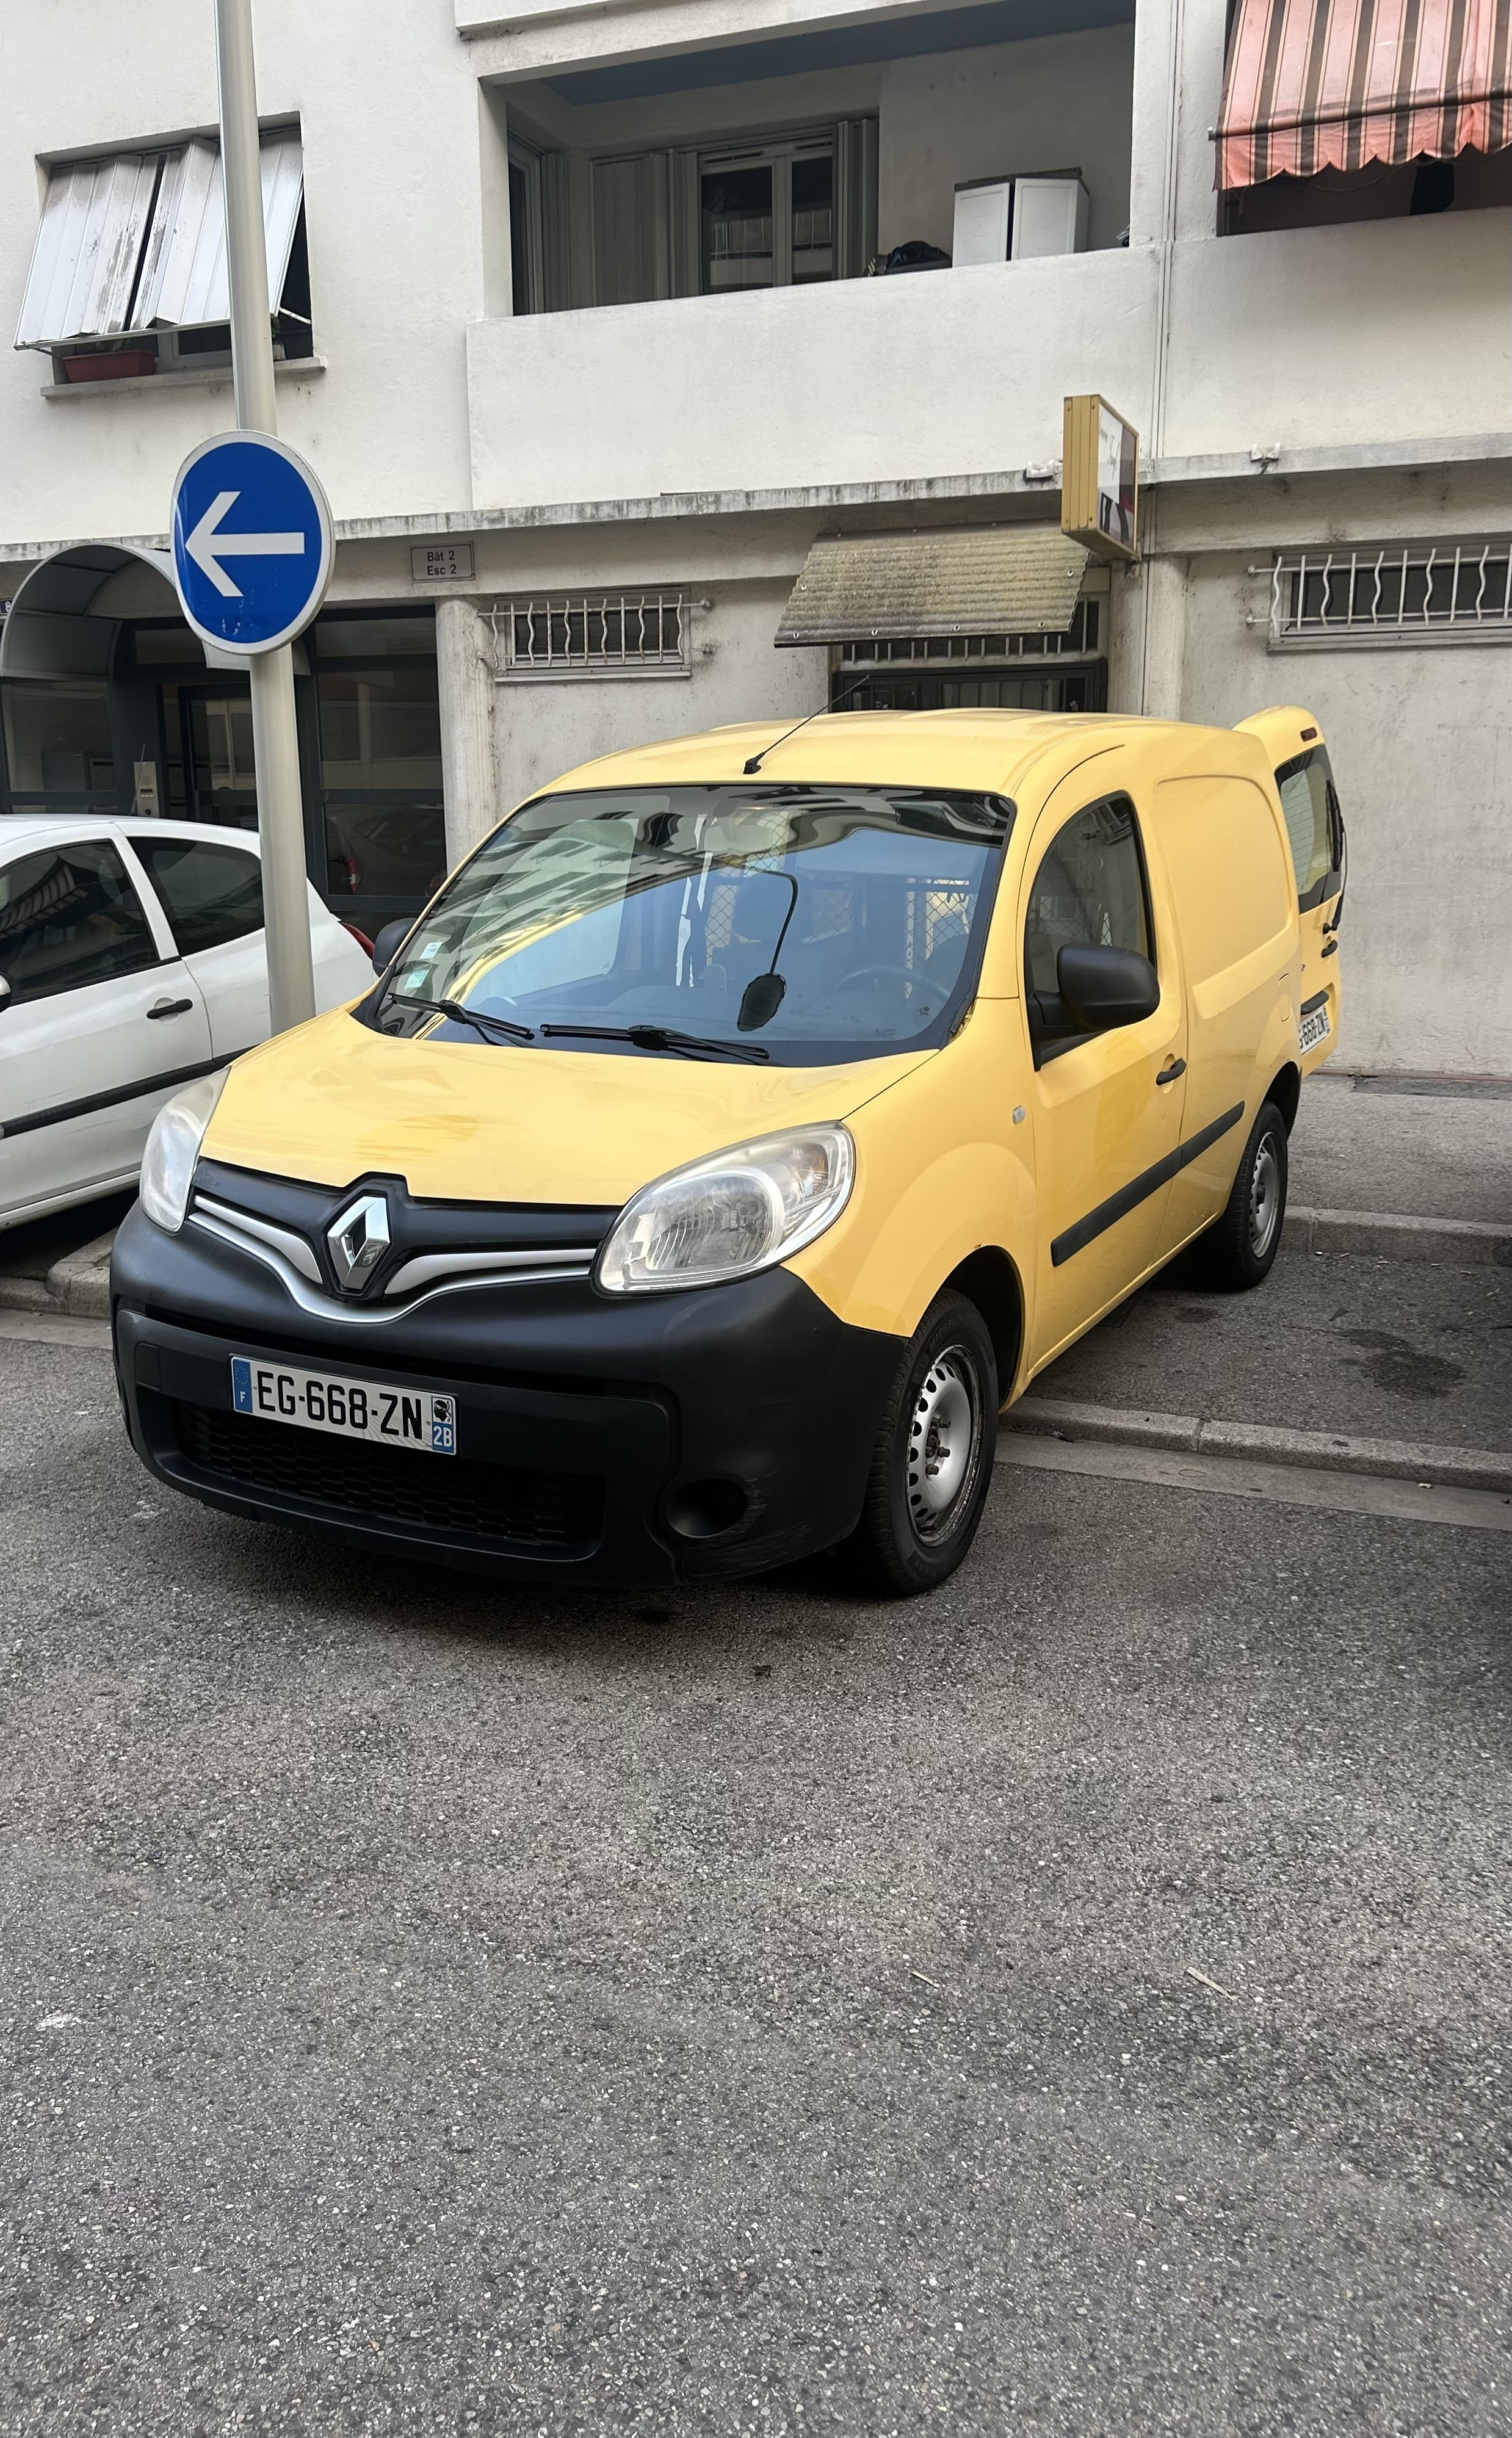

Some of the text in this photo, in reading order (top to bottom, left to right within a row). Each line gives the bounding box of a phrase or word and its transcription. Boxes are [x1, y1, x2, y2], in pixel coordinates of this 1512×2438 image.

[427, 550, 455, 562] Bât 2
[427, 564, 457, 576] Esc 2
[240, 1370, 452, 1447] F EG-668-ZN 2B
